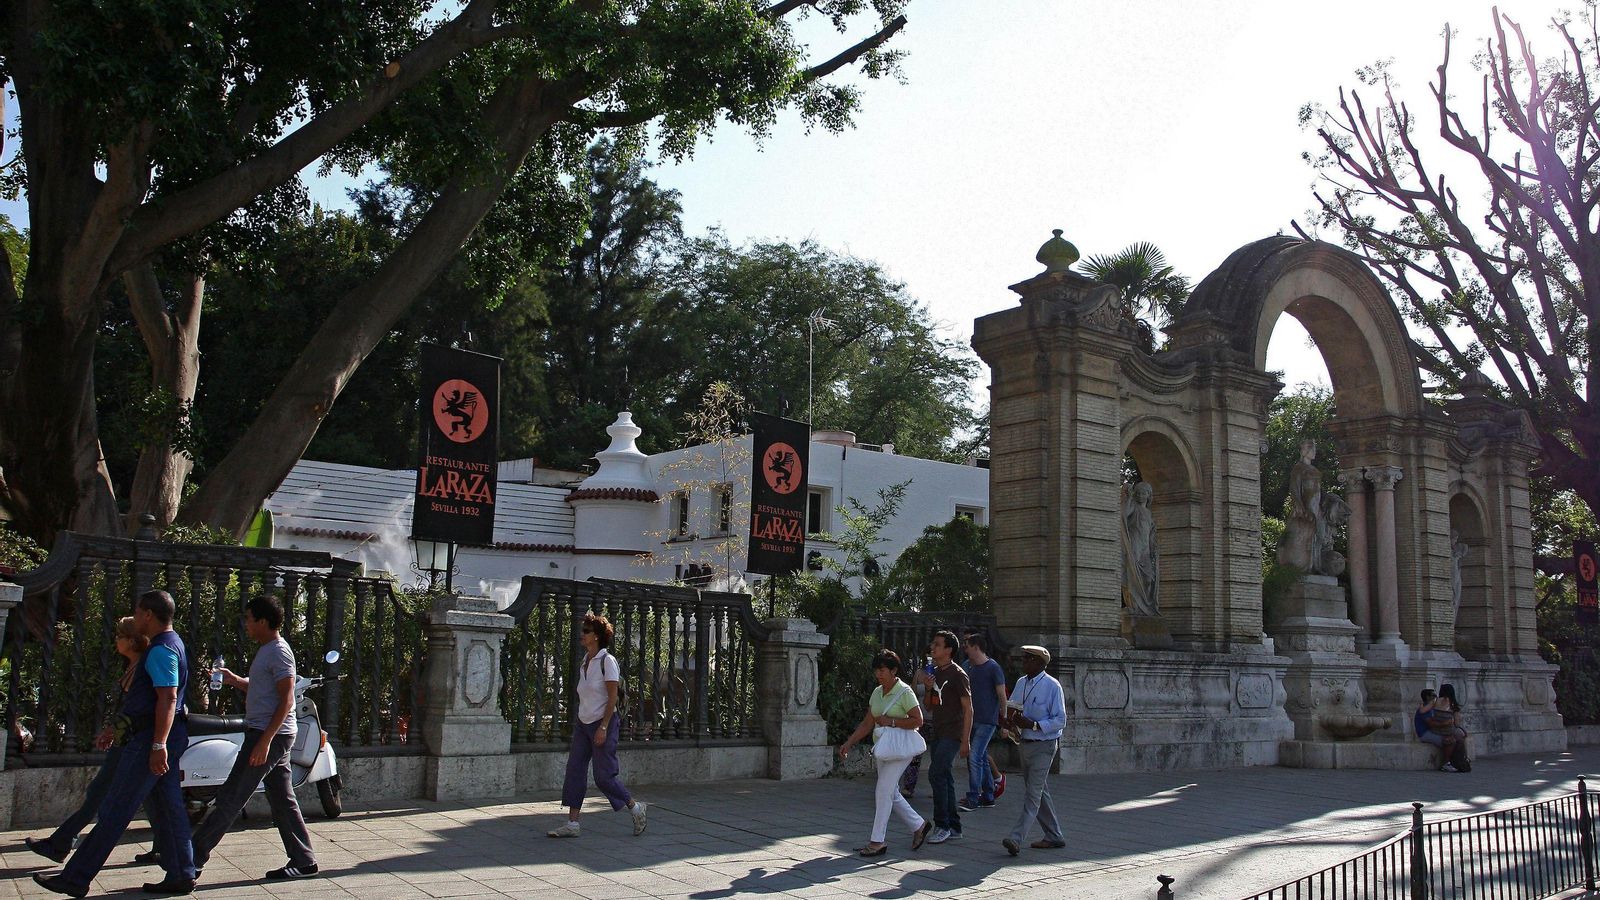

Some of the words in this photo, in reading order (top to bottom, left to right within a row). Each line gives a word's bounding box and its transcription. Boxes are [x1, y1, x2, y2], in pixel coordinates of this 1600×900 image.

[426, 456, 490, 472] RESTAURANTE
[431, 502, 458, 514] SEVILLA
[462, 506, 480, 516] 1932
[757, 504, 803, 518] RESTAURANTE
